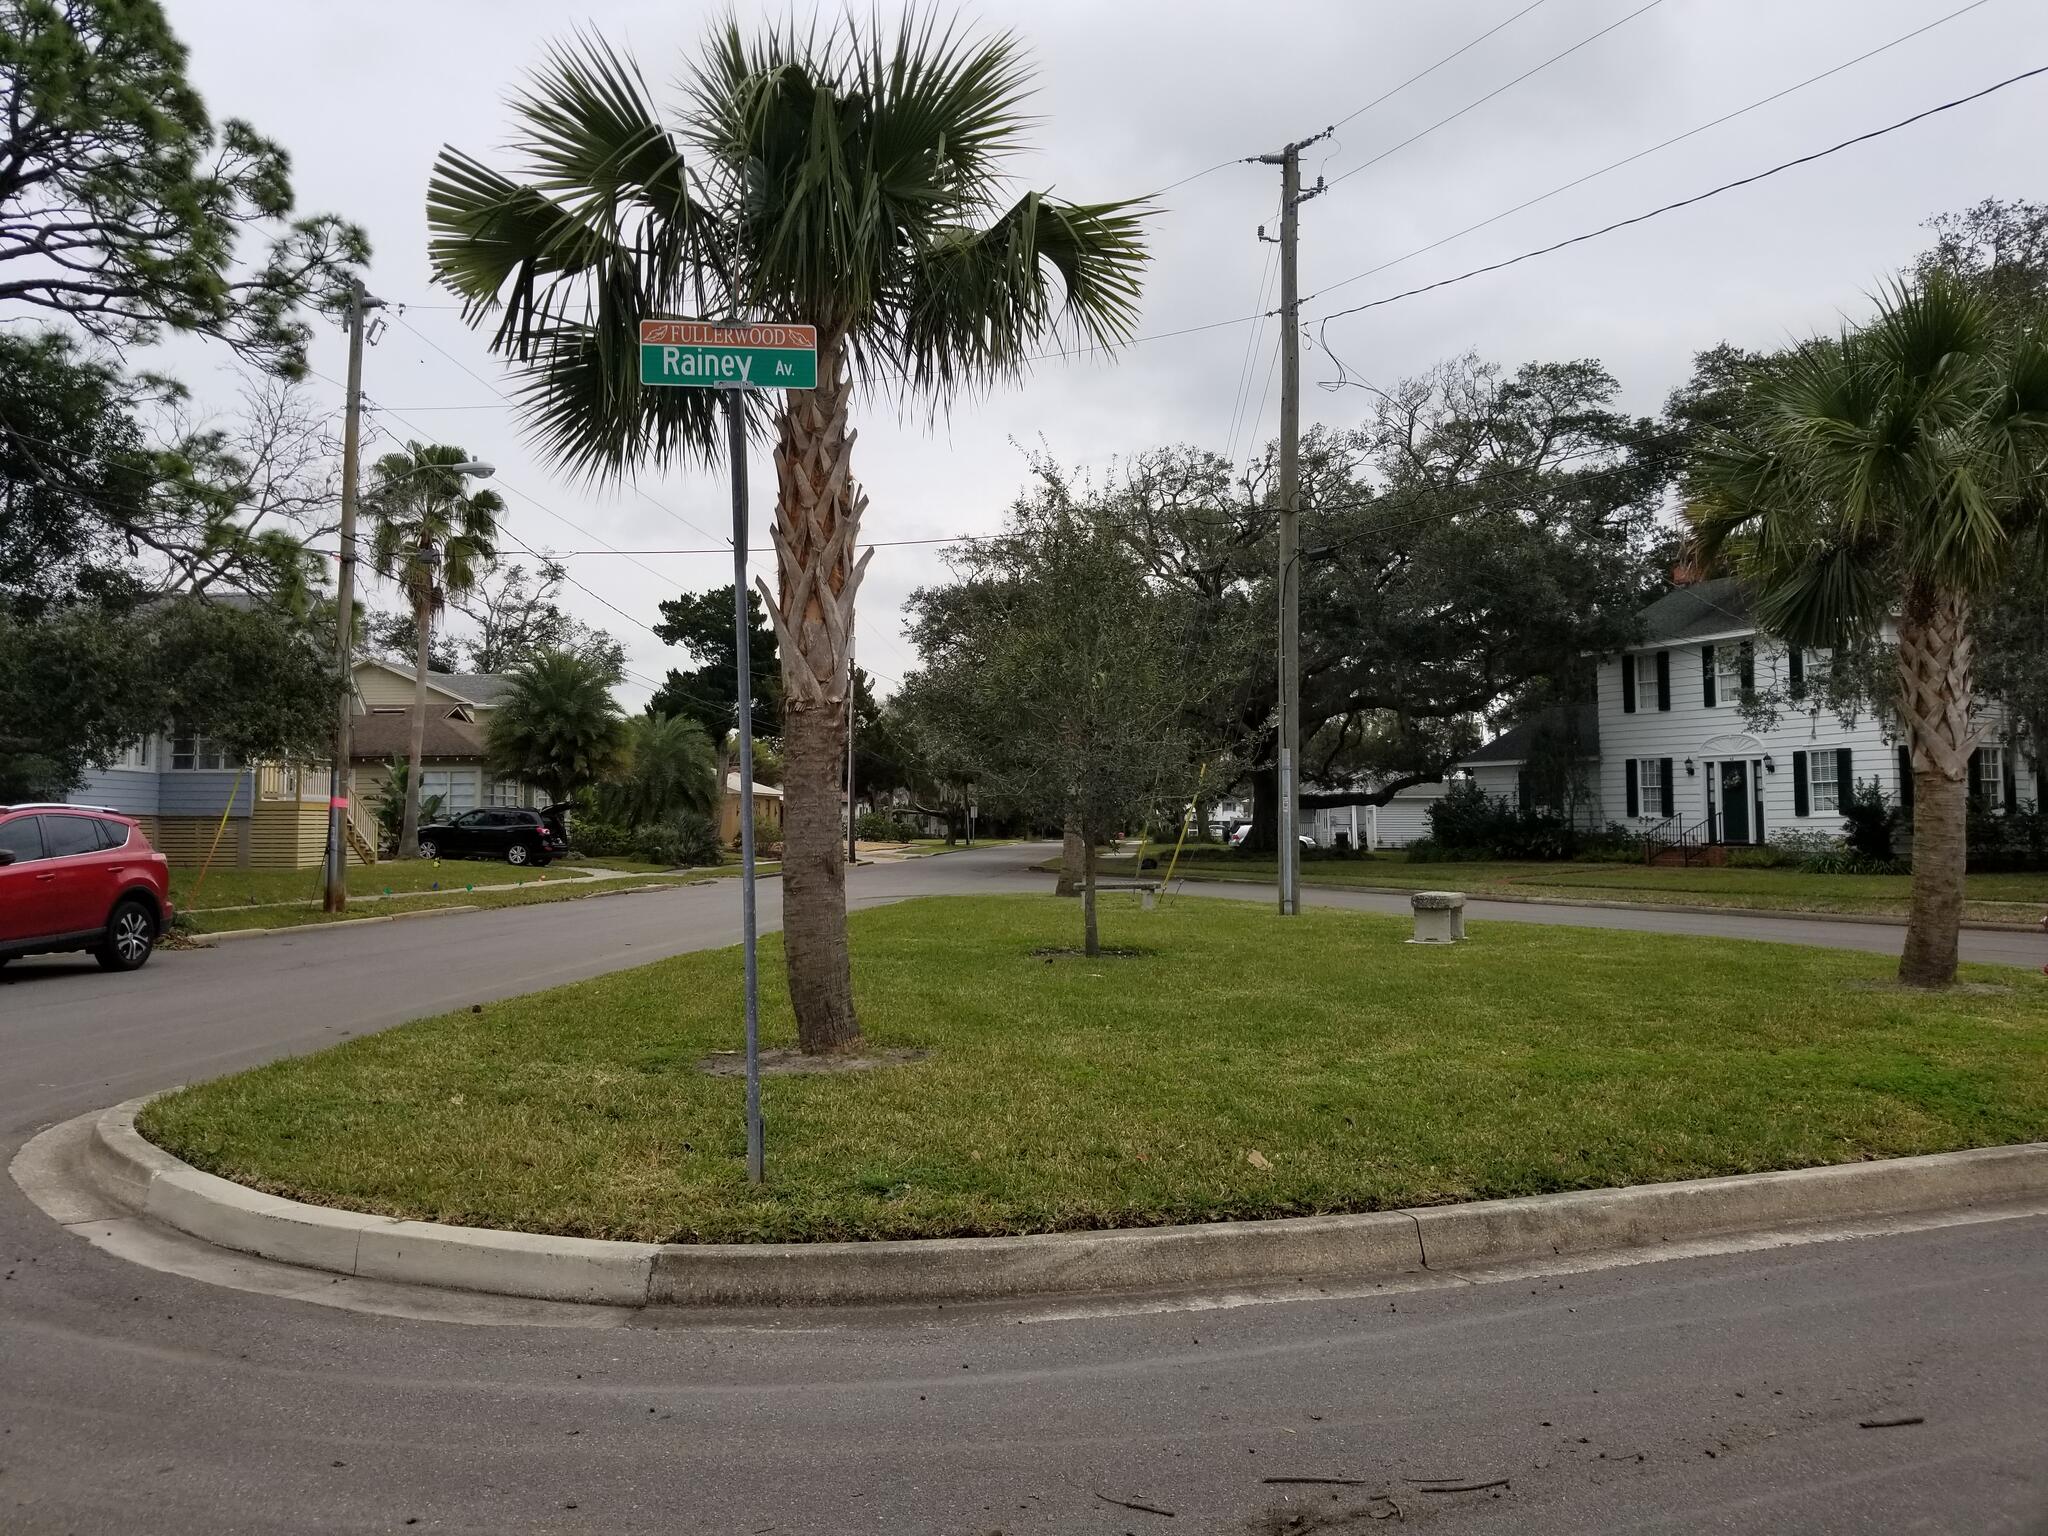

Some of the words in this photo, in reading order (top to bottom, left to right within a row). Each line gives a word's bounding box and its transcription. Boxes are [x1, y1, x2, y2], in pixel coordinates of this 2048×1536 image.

[671, 325, 785, 345] FULLERWOOD
[663, 346, 752, 381] Rainey
[775, 360, 795, 376] Av.
